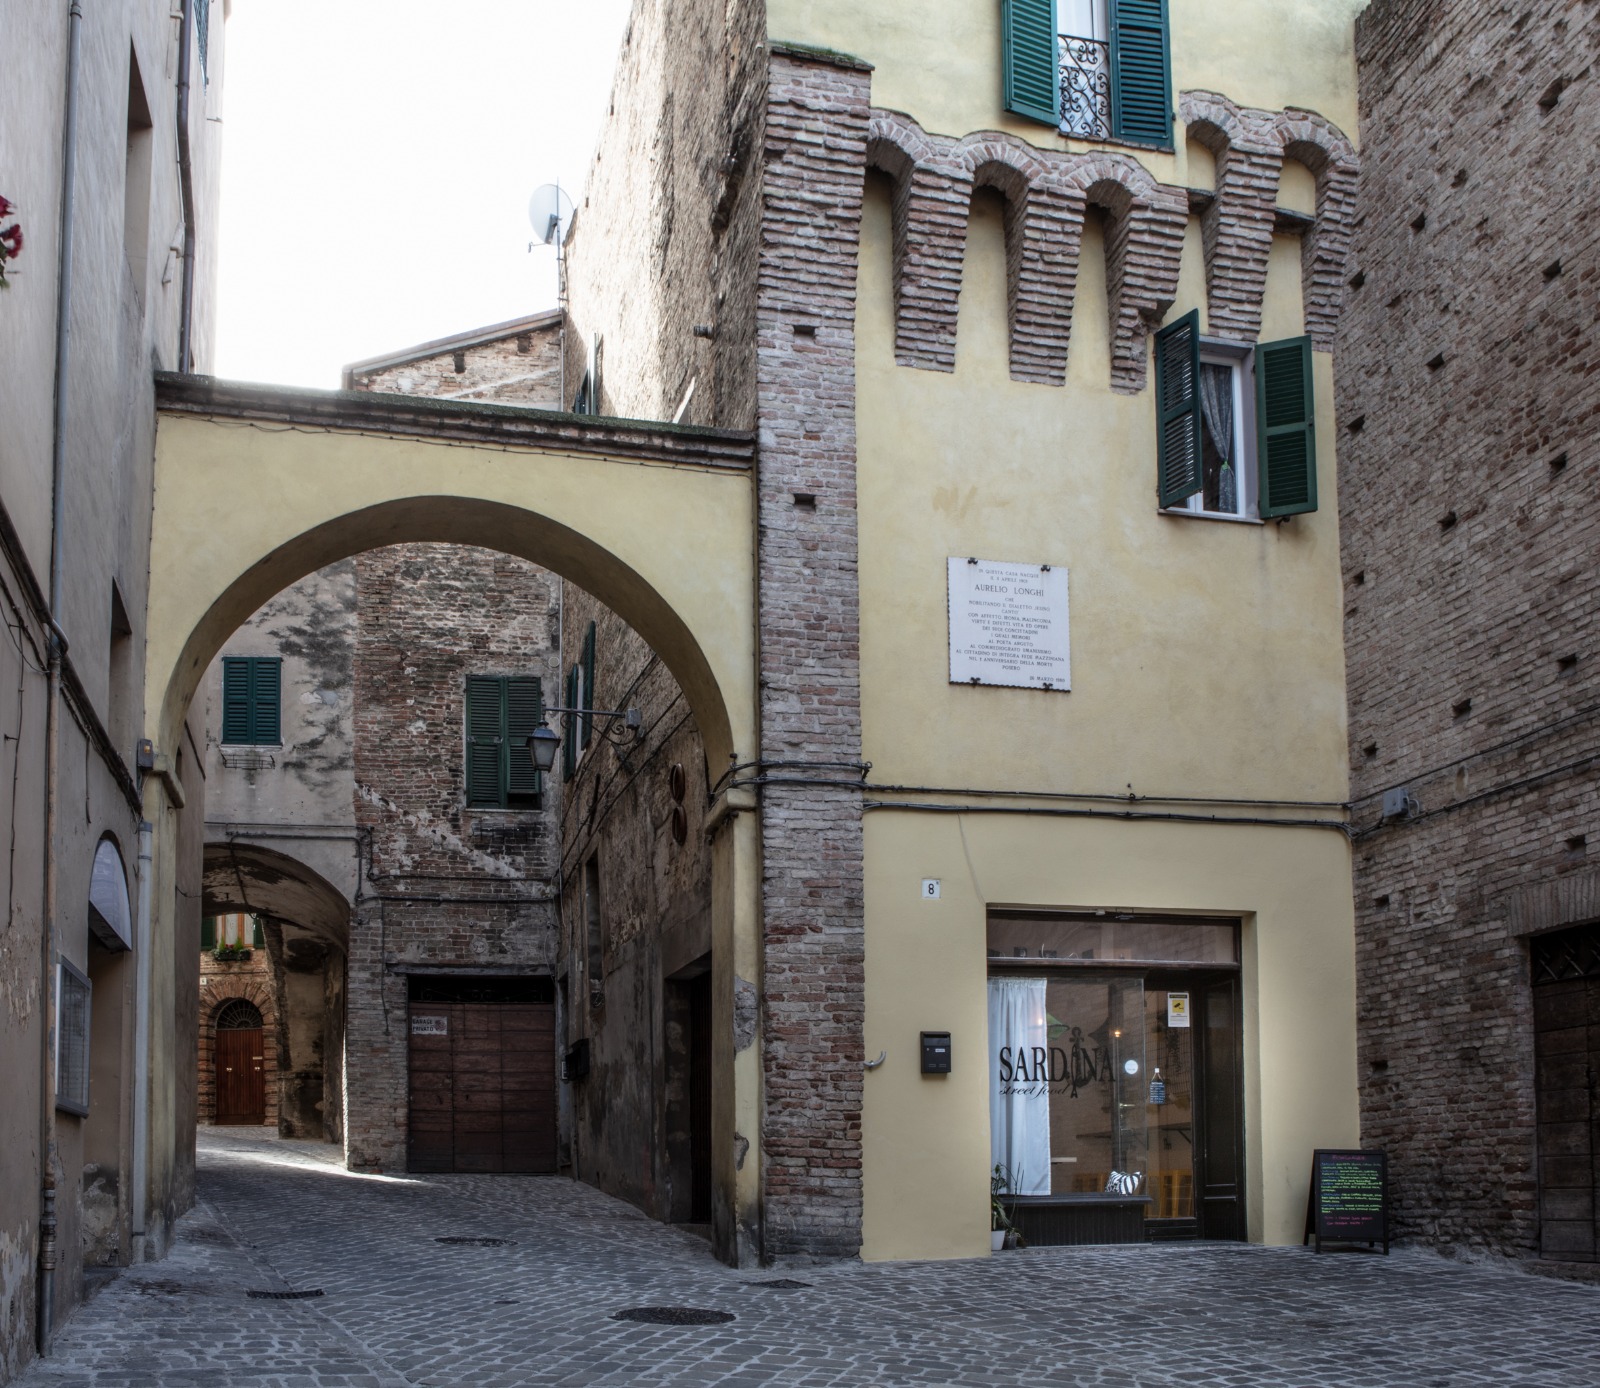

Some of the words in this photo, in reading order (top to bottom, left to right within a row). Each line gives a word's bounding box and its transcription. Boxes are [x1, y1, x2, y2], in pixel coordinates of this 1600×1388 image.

[975, 584, 1007, 593] AURELIO
[1014, 587, 1044, 596] LONGHI
[928, 883, 934, 894] 8
[1000, 1045, 1116, 1084] SARDINA
[999, 1084, 1034, 1096] street
[1033, 1084, 1070, 1100] food
